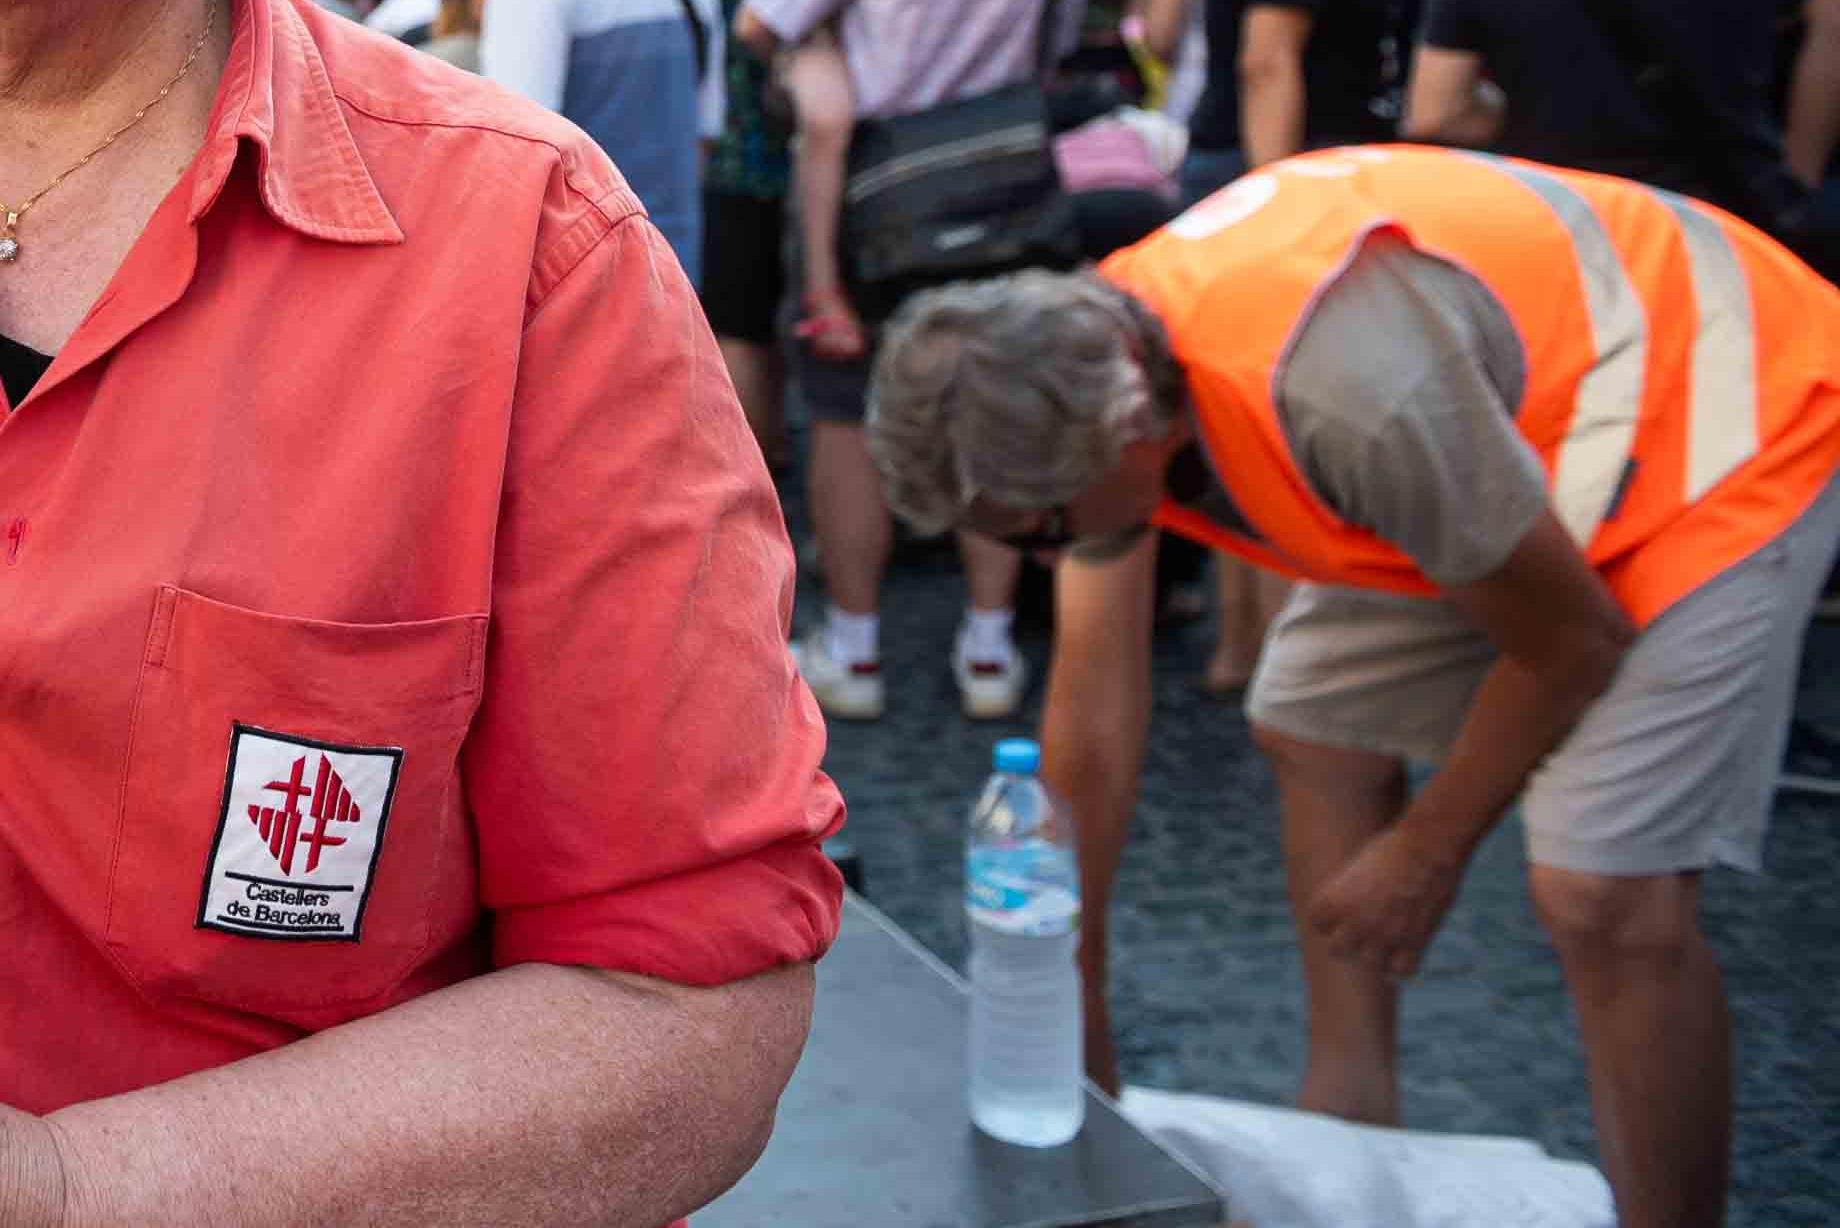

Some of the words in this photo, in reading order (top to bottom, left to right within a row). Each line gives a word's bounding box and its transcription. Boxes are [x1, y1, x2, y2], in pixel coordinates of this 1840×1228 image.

[246, 882, 330, 907] Castellers
[226, 899, 251, 918] de
[254, 904, 341, 926] Barcelona
